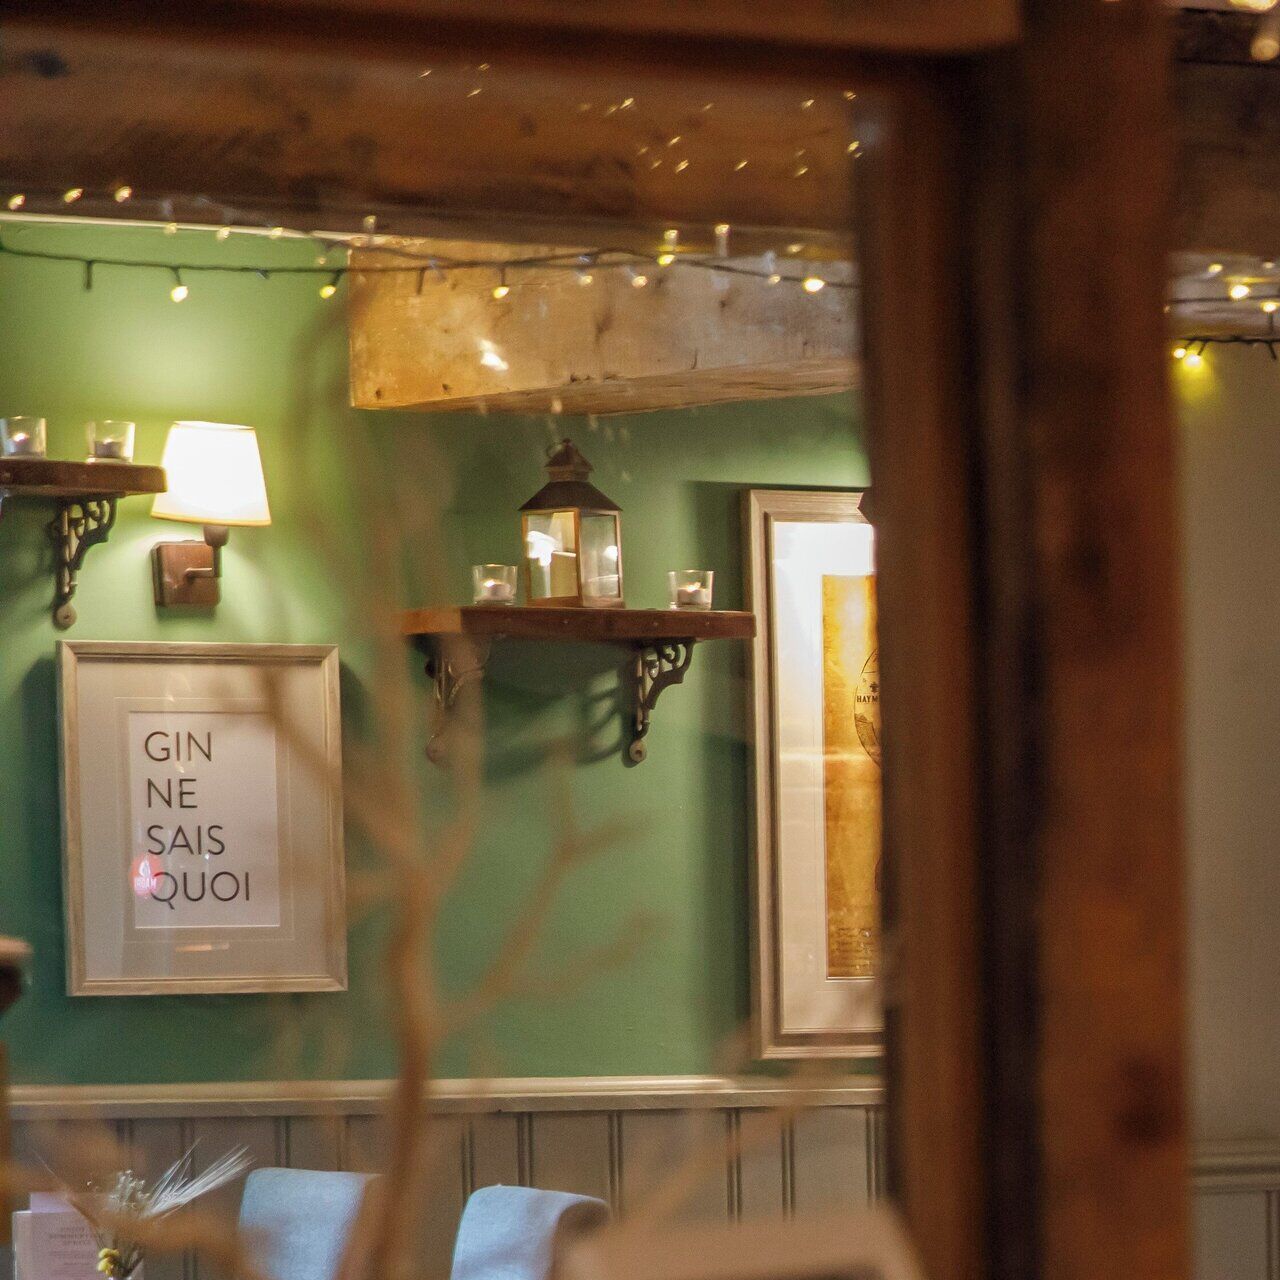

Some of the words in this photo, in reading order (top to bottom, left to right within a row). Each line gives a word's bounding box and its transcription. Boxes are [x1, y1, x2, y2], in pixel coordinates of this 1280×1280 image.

[144, 731, 212, 762] GIN
[147, 778, 198, 808] NE
[147, 825, 225, 855] SAIS
[150, 871, 250, 909] QUOI
